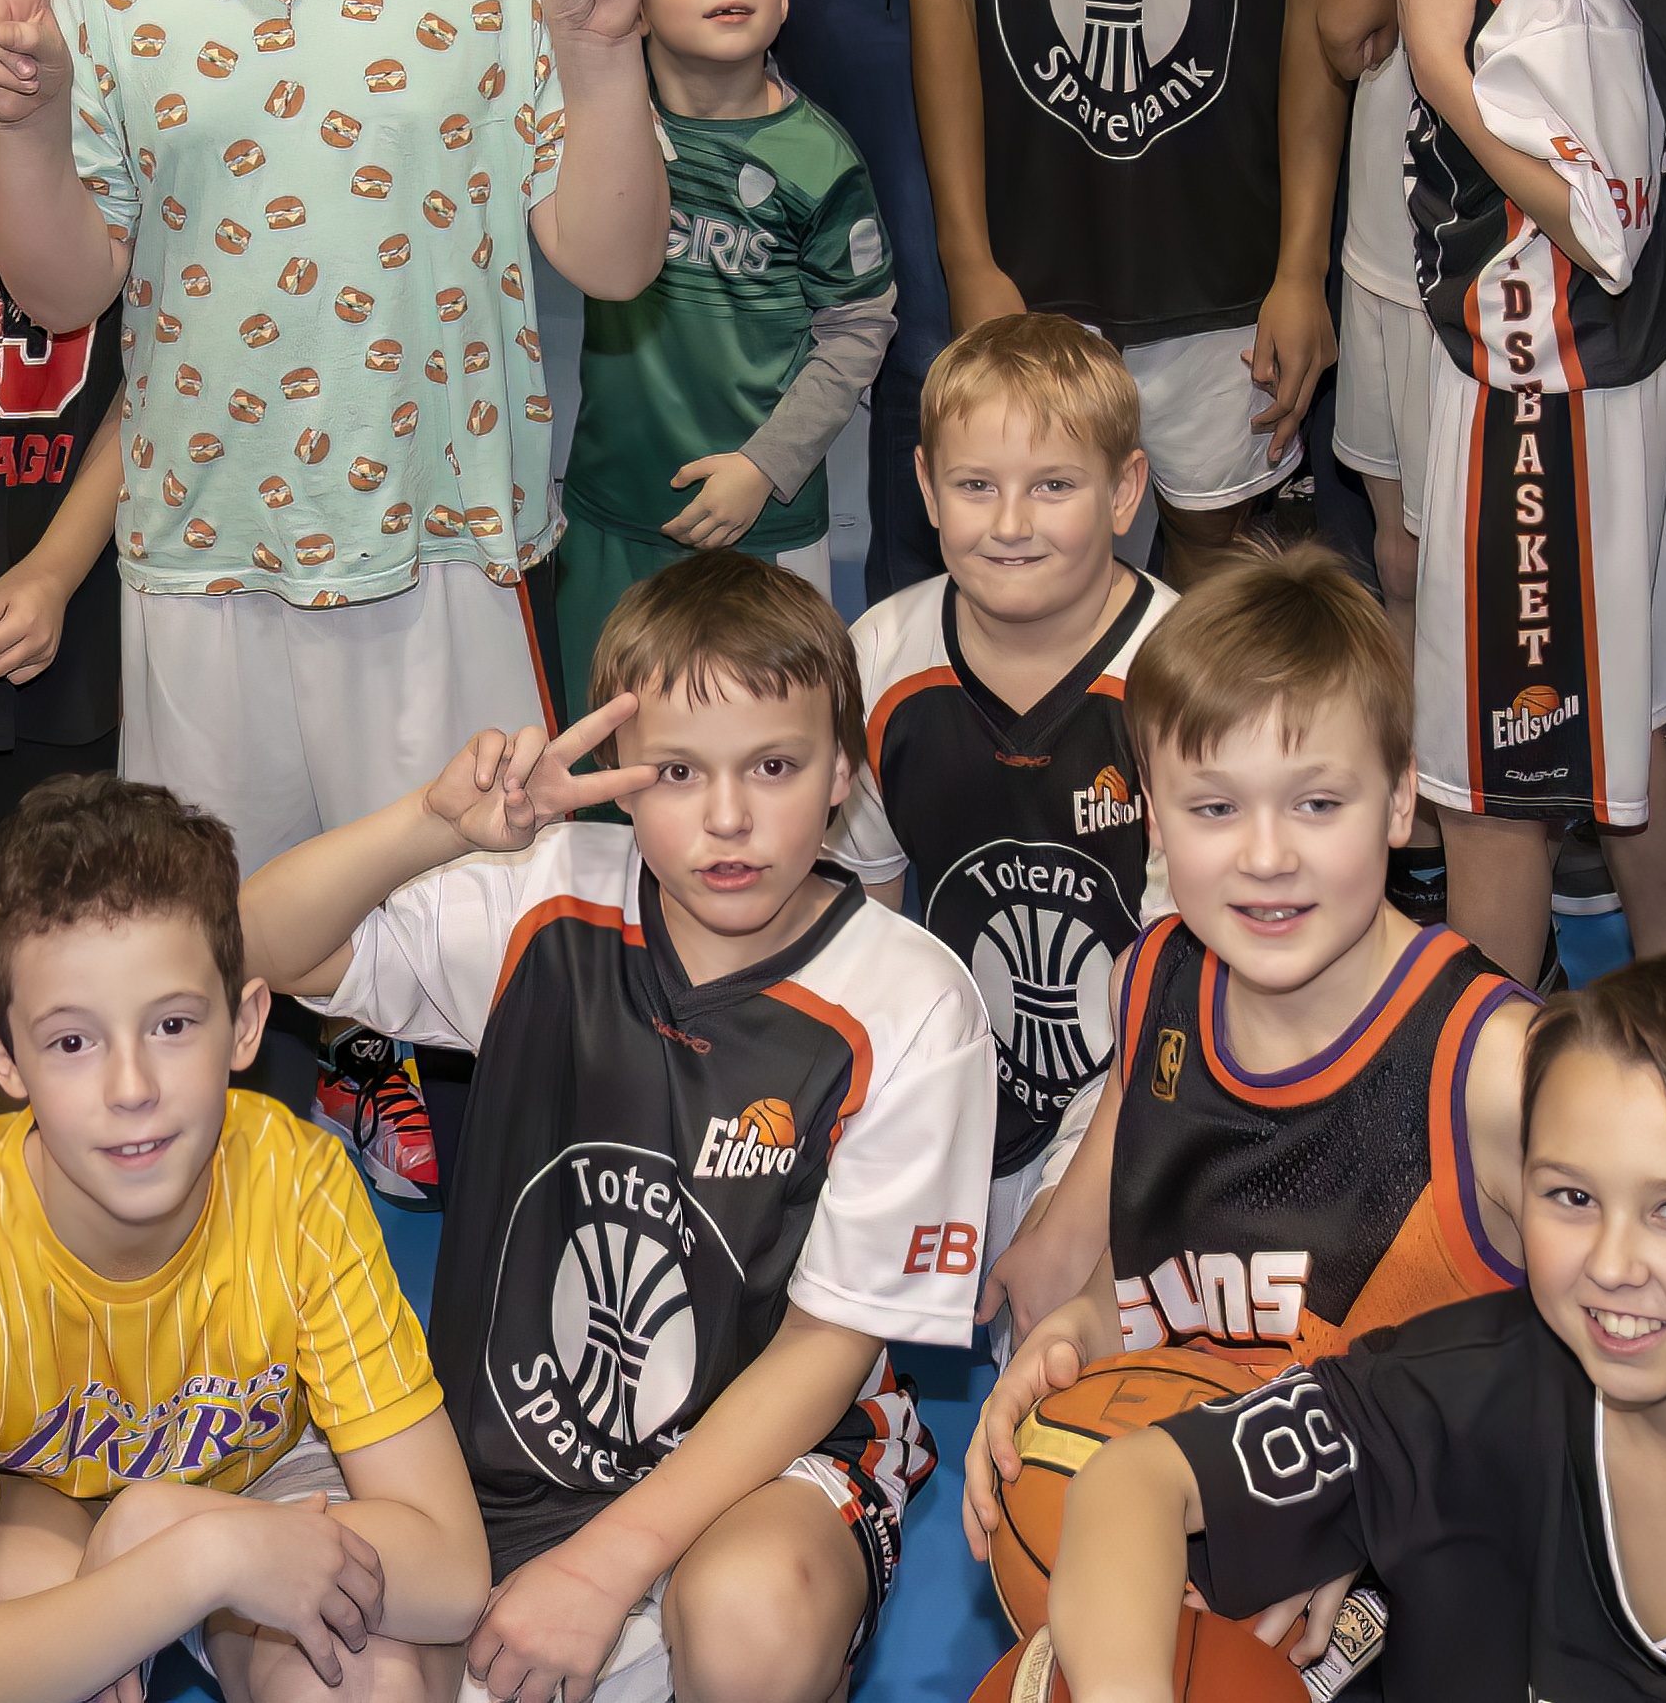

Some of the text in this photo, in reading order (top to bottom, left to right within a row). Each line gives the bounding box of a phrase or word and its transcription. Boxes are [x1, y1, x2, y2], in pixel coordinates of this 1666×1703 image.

[1033, 45, 1215, 144] Sparebank
[1513, 390, 1552, 668] BASKET
[1491, 694, 1580, 750] Eidsvoll
[965, 855, 1098, 903] Totens
[693, 1115, 801, 1179] Eidsvo
